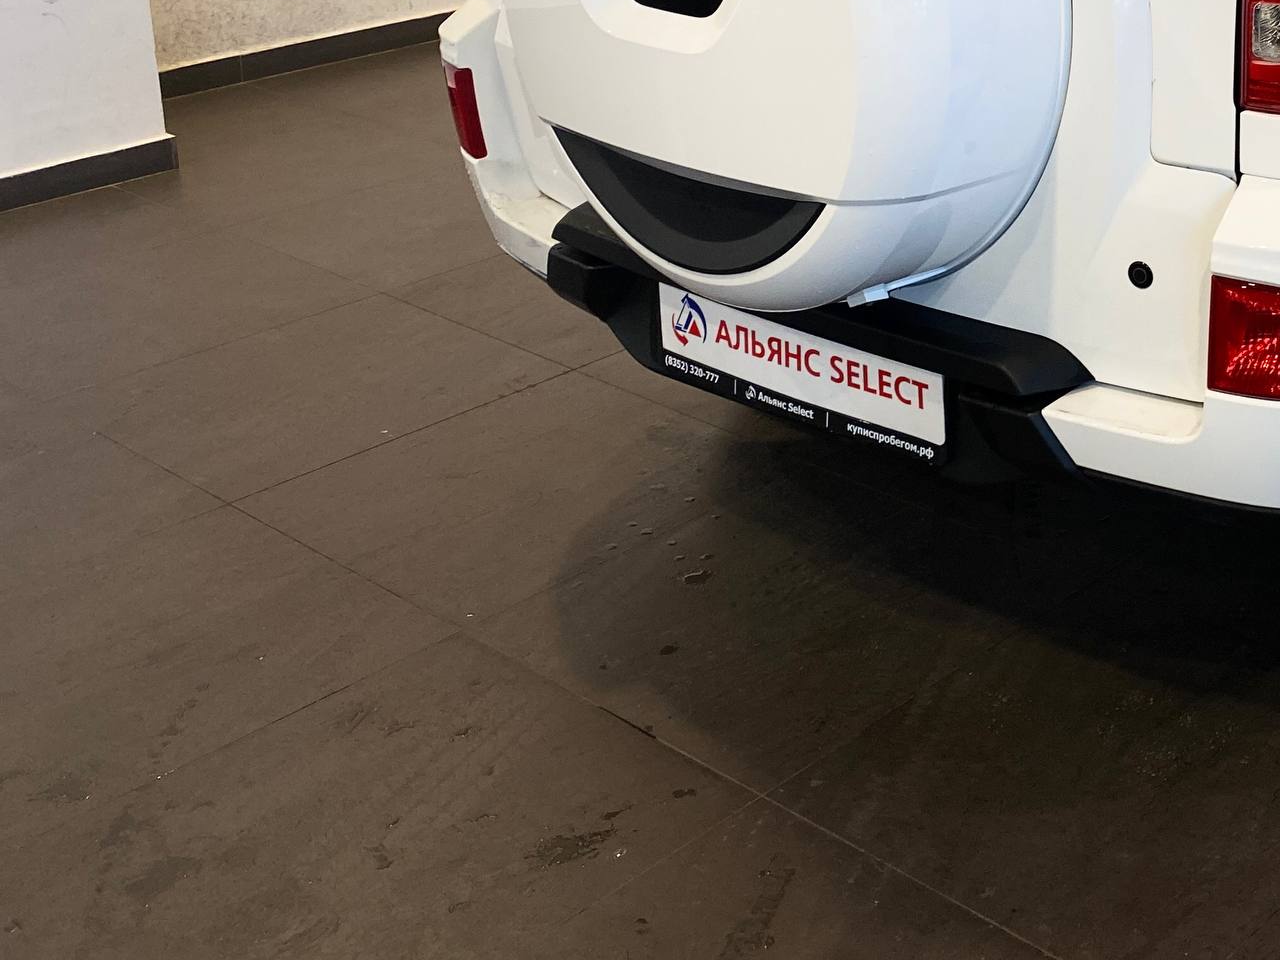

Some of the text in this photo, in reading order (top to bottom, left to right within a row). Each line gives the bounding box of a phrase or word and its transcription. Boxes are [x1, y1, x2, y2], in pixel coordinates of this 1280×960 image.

[665, 354, 720, 384] (8352) 320-777
[715, 319, 929, 410] АЛЬЯНС SELECT
[757, 391, 815, 420] Альянс Select
[846, 423, 935, 460] куписпробегом.рф
